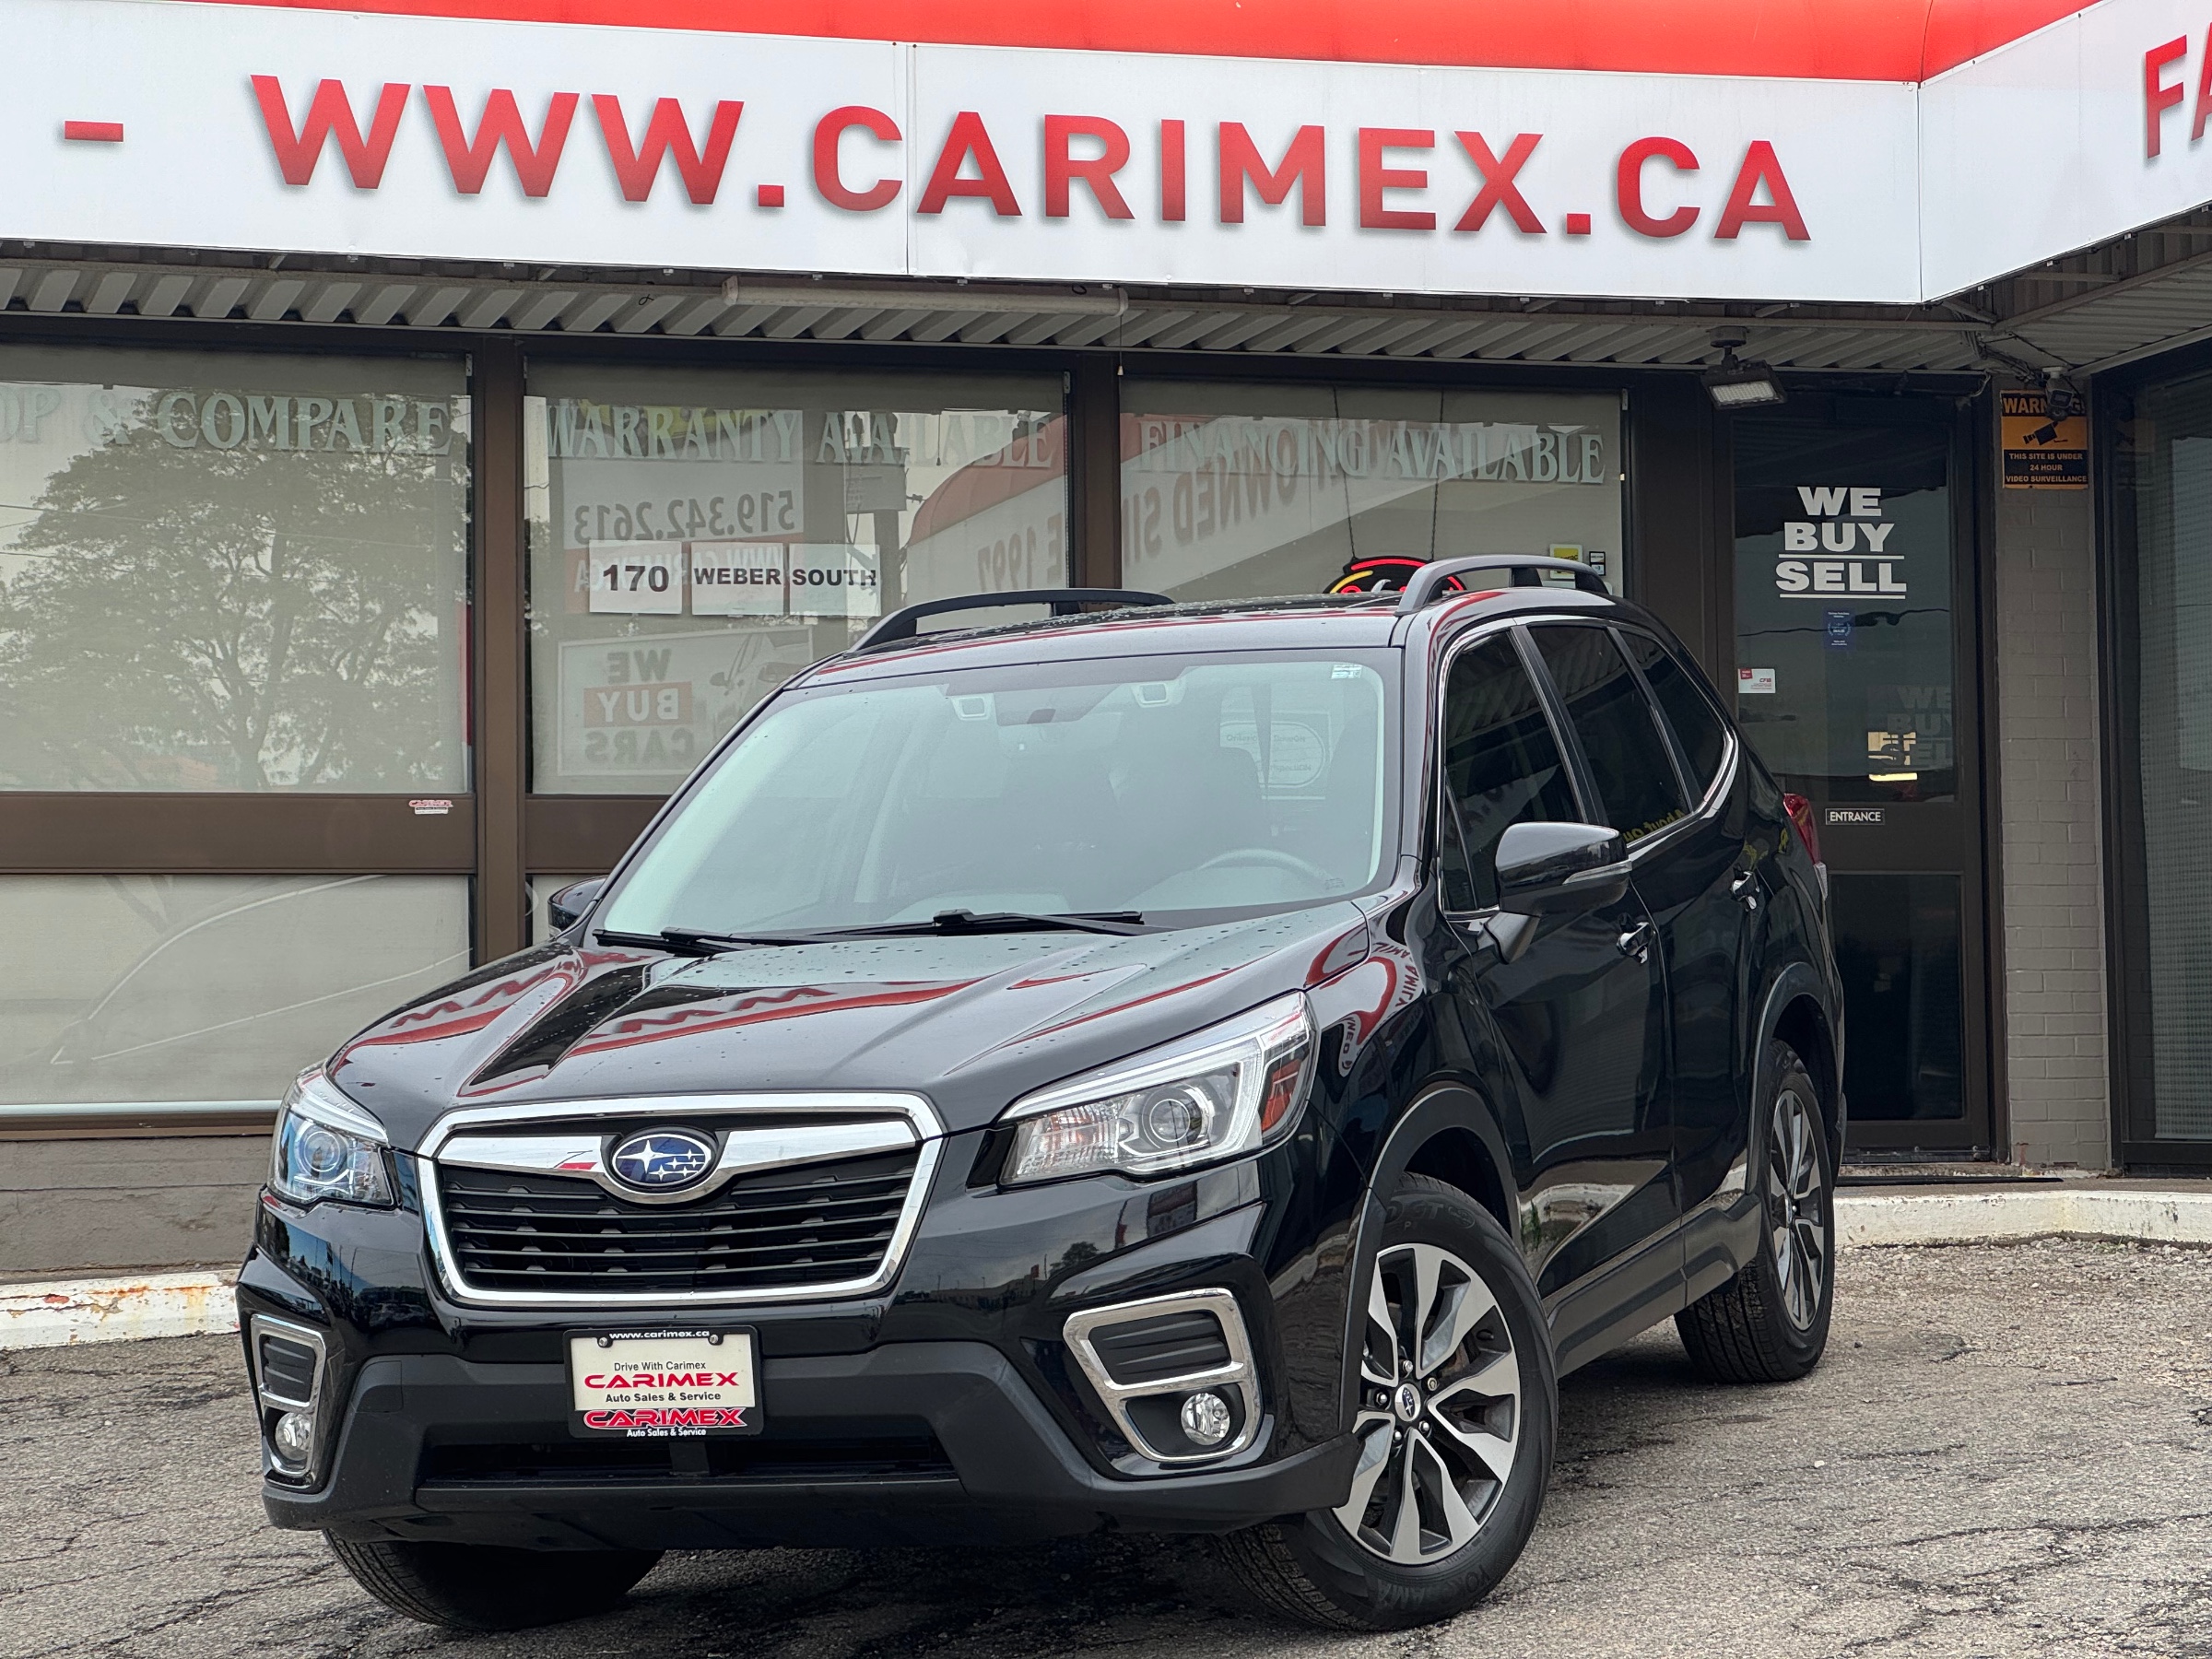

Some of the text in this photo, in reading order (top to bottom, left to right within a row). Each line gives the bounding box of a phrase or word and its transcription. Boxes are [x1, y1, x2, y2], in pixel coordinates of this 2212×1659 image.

[250, 75, 1812, 241] WWW.CARIMEX.CA
[158, 392, 452, 455] COMPARE
[547, 404, 1054, 468] WARRANTY AVAILABLE
[1139, 419, 1371, 477] FINANCING
[1385, 424, 1606, 485] AVAILABLE
[1797, 487, 1881, 516] WE
[1784, 522, 1895, 552] BUY
[603, 564, 877, 593] 170 WEBER SOUTH
[1775, 561, 1907, 592] SELL
[1830, 811, 1881, 822] ENTRANCE
[609, 1329, 710, 1339] www.carimex.ca
[583, 1371, 739, 1389] CARIMEX
[614, 1360, 707, 1371] Drive With Carimex
[606, 1392, 722, 1403] Auto Sales & Service
[583, 1407, 747, 1430] CARIMEX
[626, 1428, 707, 1438] Auto Sales & Service
